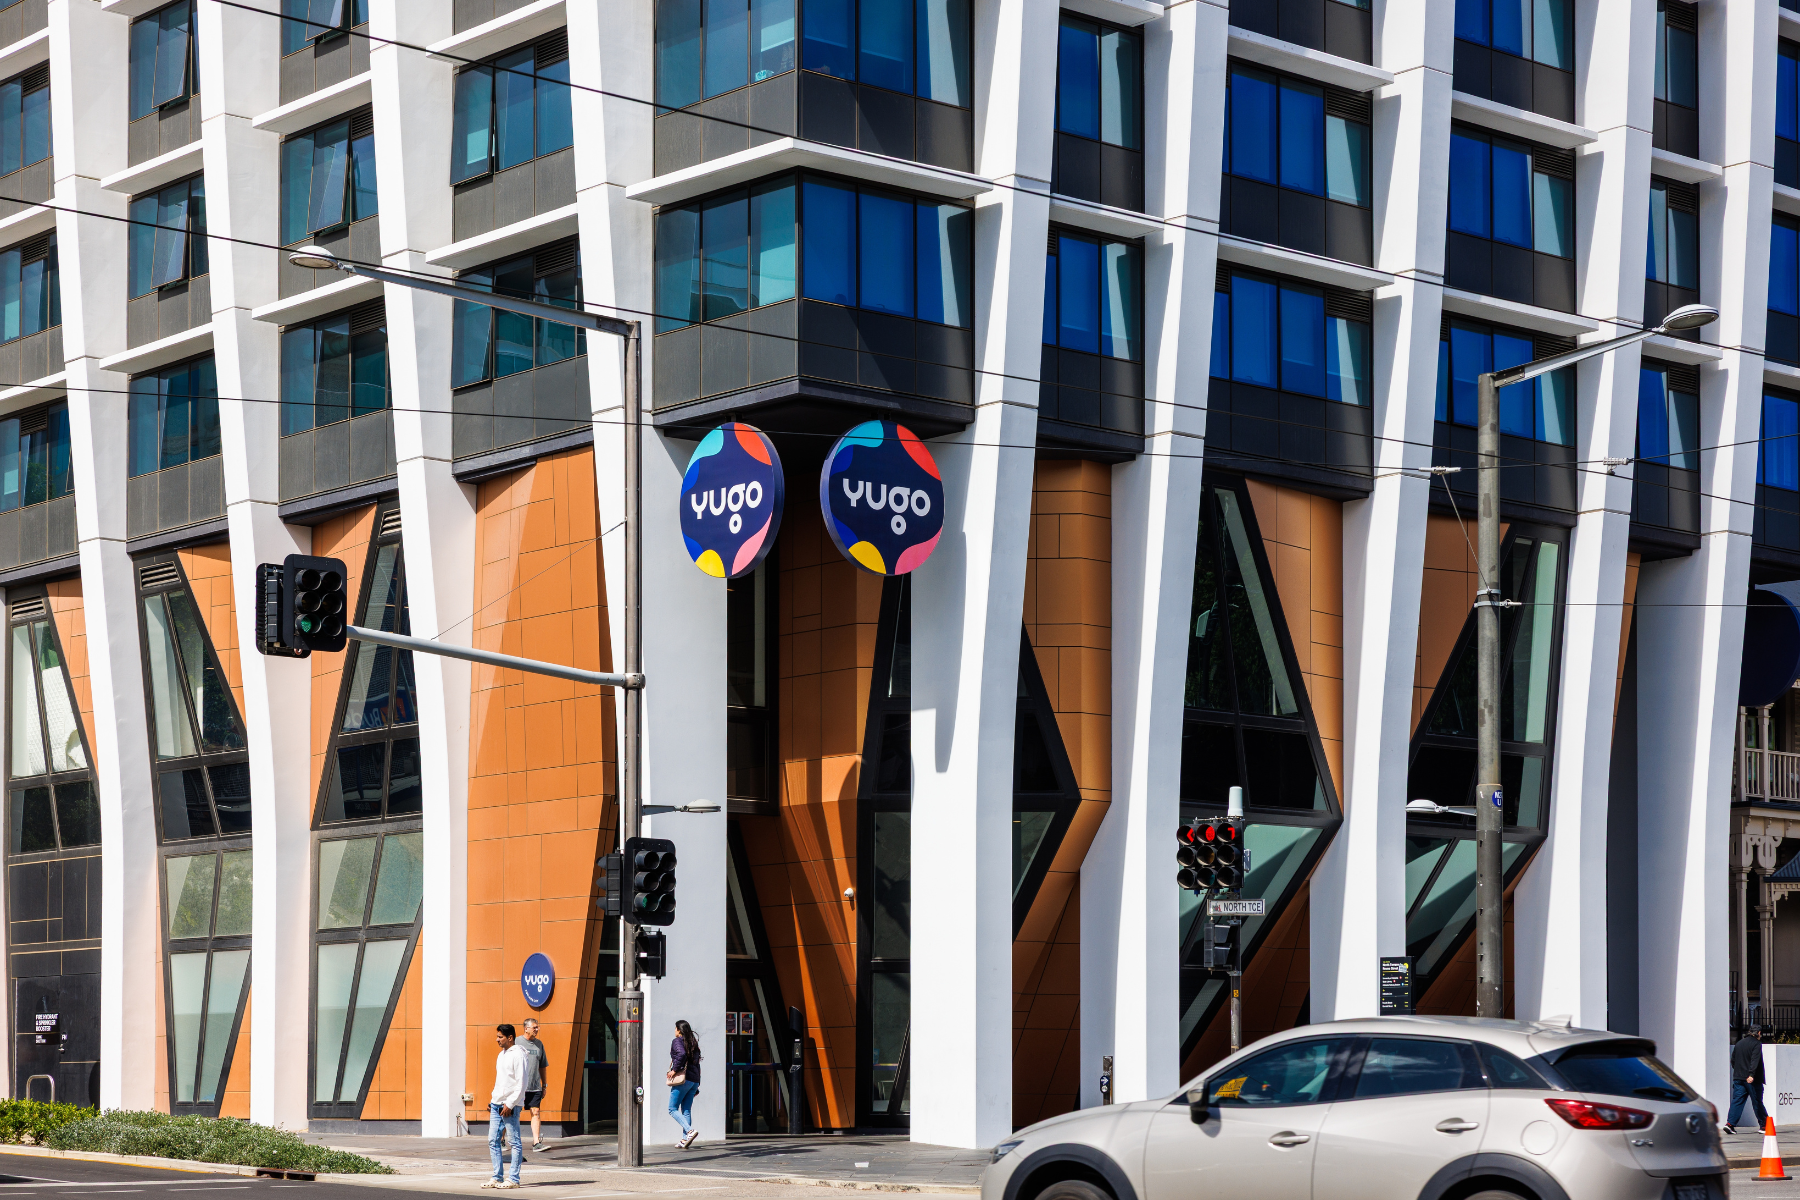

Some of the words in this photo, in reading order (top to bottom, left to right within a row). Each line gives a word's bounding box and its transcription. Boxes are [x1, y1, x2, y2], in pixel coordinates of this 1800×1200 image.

[691, 480, 763, 535] yugo
[842, 478, 931, 536] yugo
[1223, 902, 1247, 912] NORTH
[1248, 902, 1261, 912] TCE
[524, 974, 549, 993] yugo
